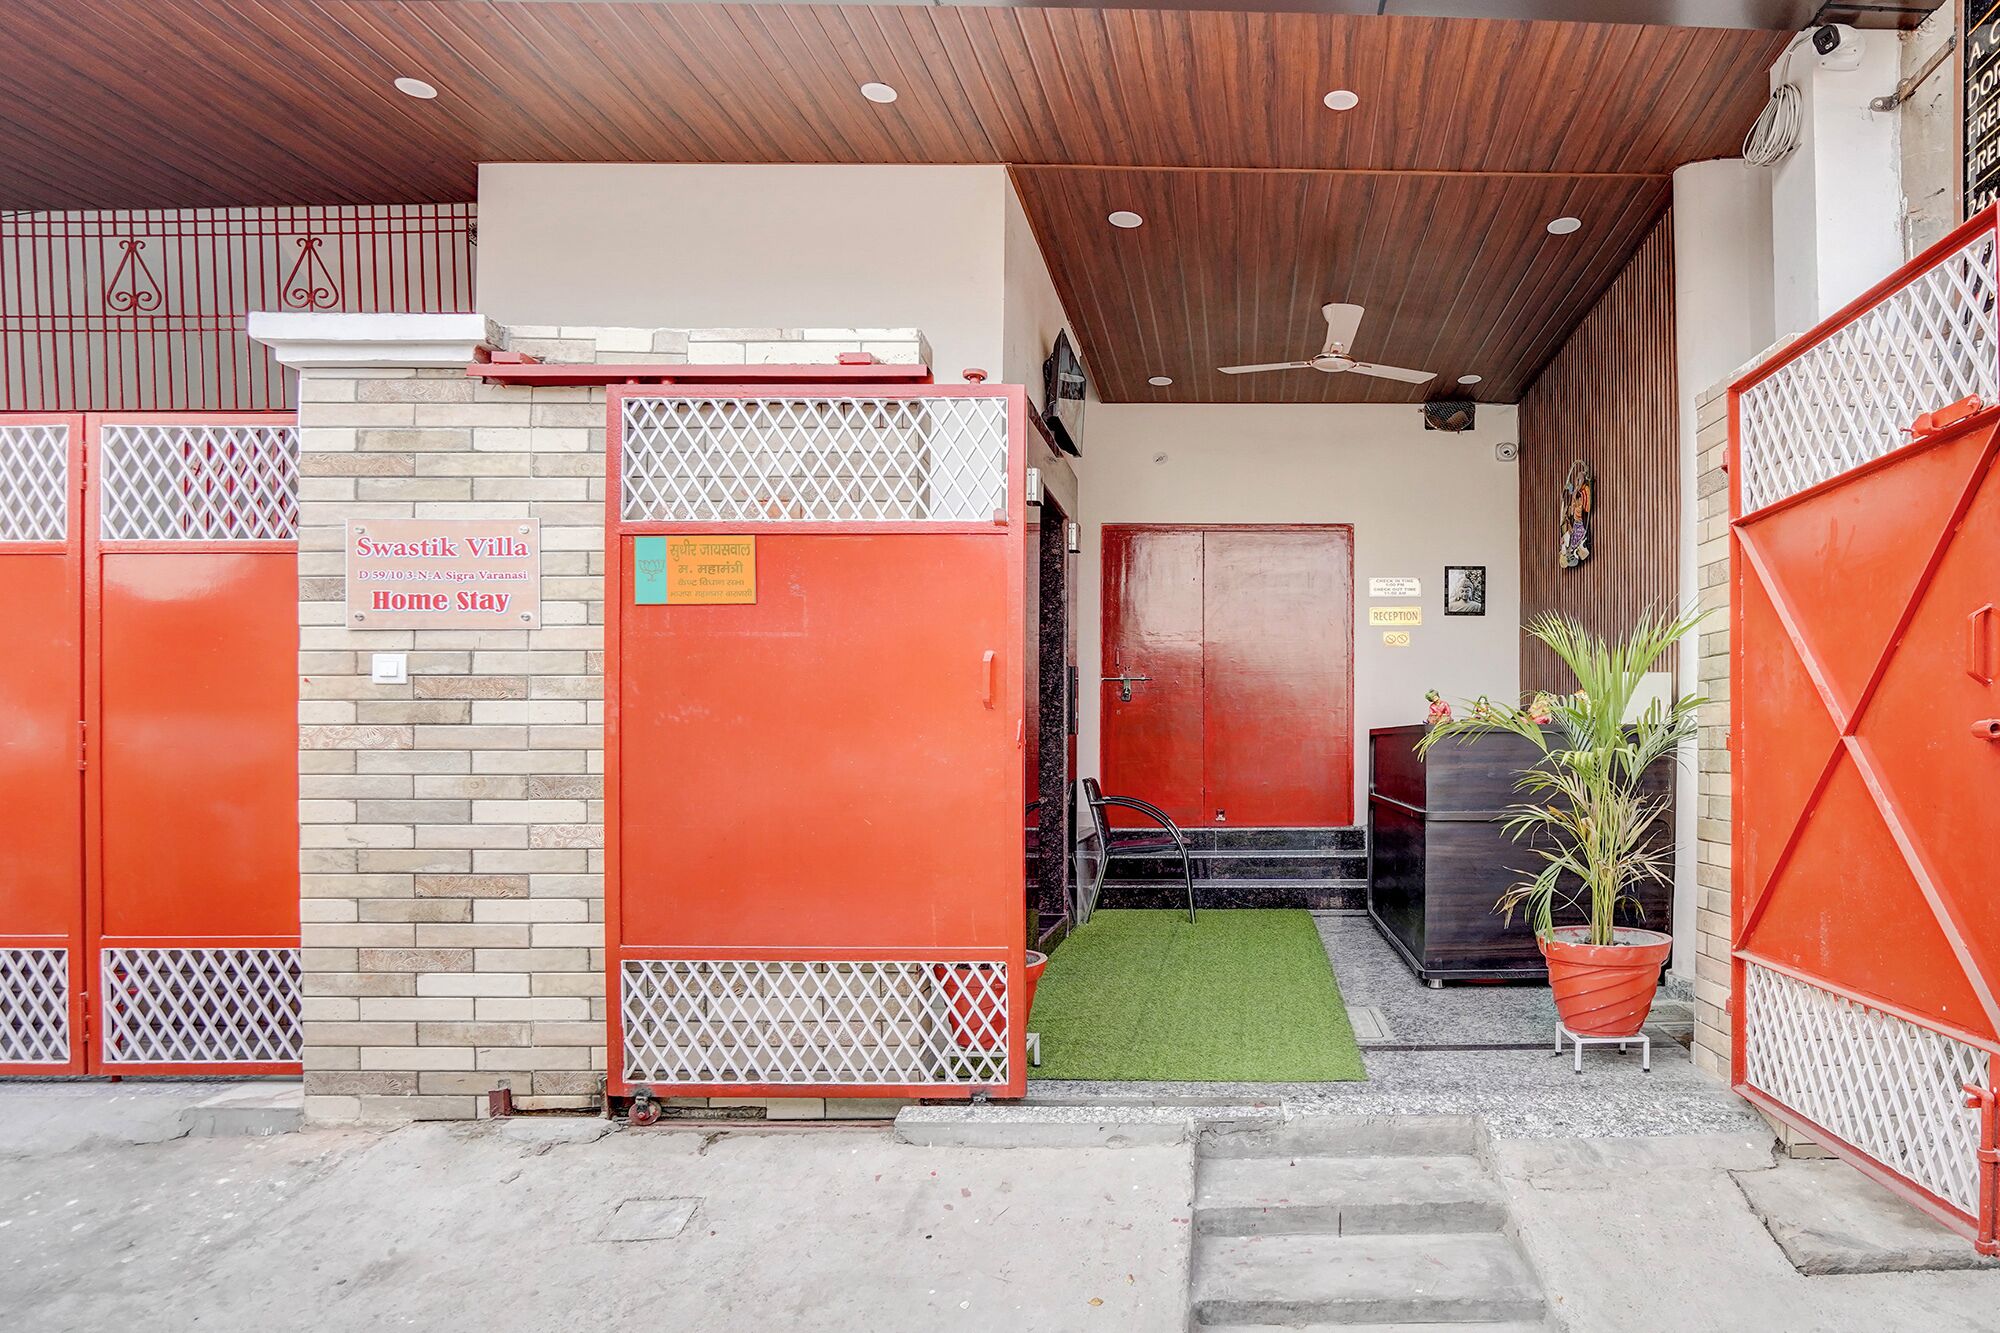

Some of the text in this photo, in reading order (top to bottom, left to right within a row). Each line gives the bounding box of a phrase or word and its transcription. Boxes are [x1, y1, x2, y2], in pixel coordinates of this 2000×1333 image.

[1967, 97, 2000, 145] FRE
[1967, 136, 2000, 182] FRE
[357, 536, 529, 557] Swastik Villa
[670, 539, 751, 561] सुधीर जायसवाल
[359, 570, 369, 579] D
[445, 571, 475, 582] Sigra
[479, 571, 528, 579] Varanasi
[697, 561, 743, 574] महामंत्री
[372, 591, 510, 612] Home Stay
[1373, 611, 1418, 621] RECEPTION
